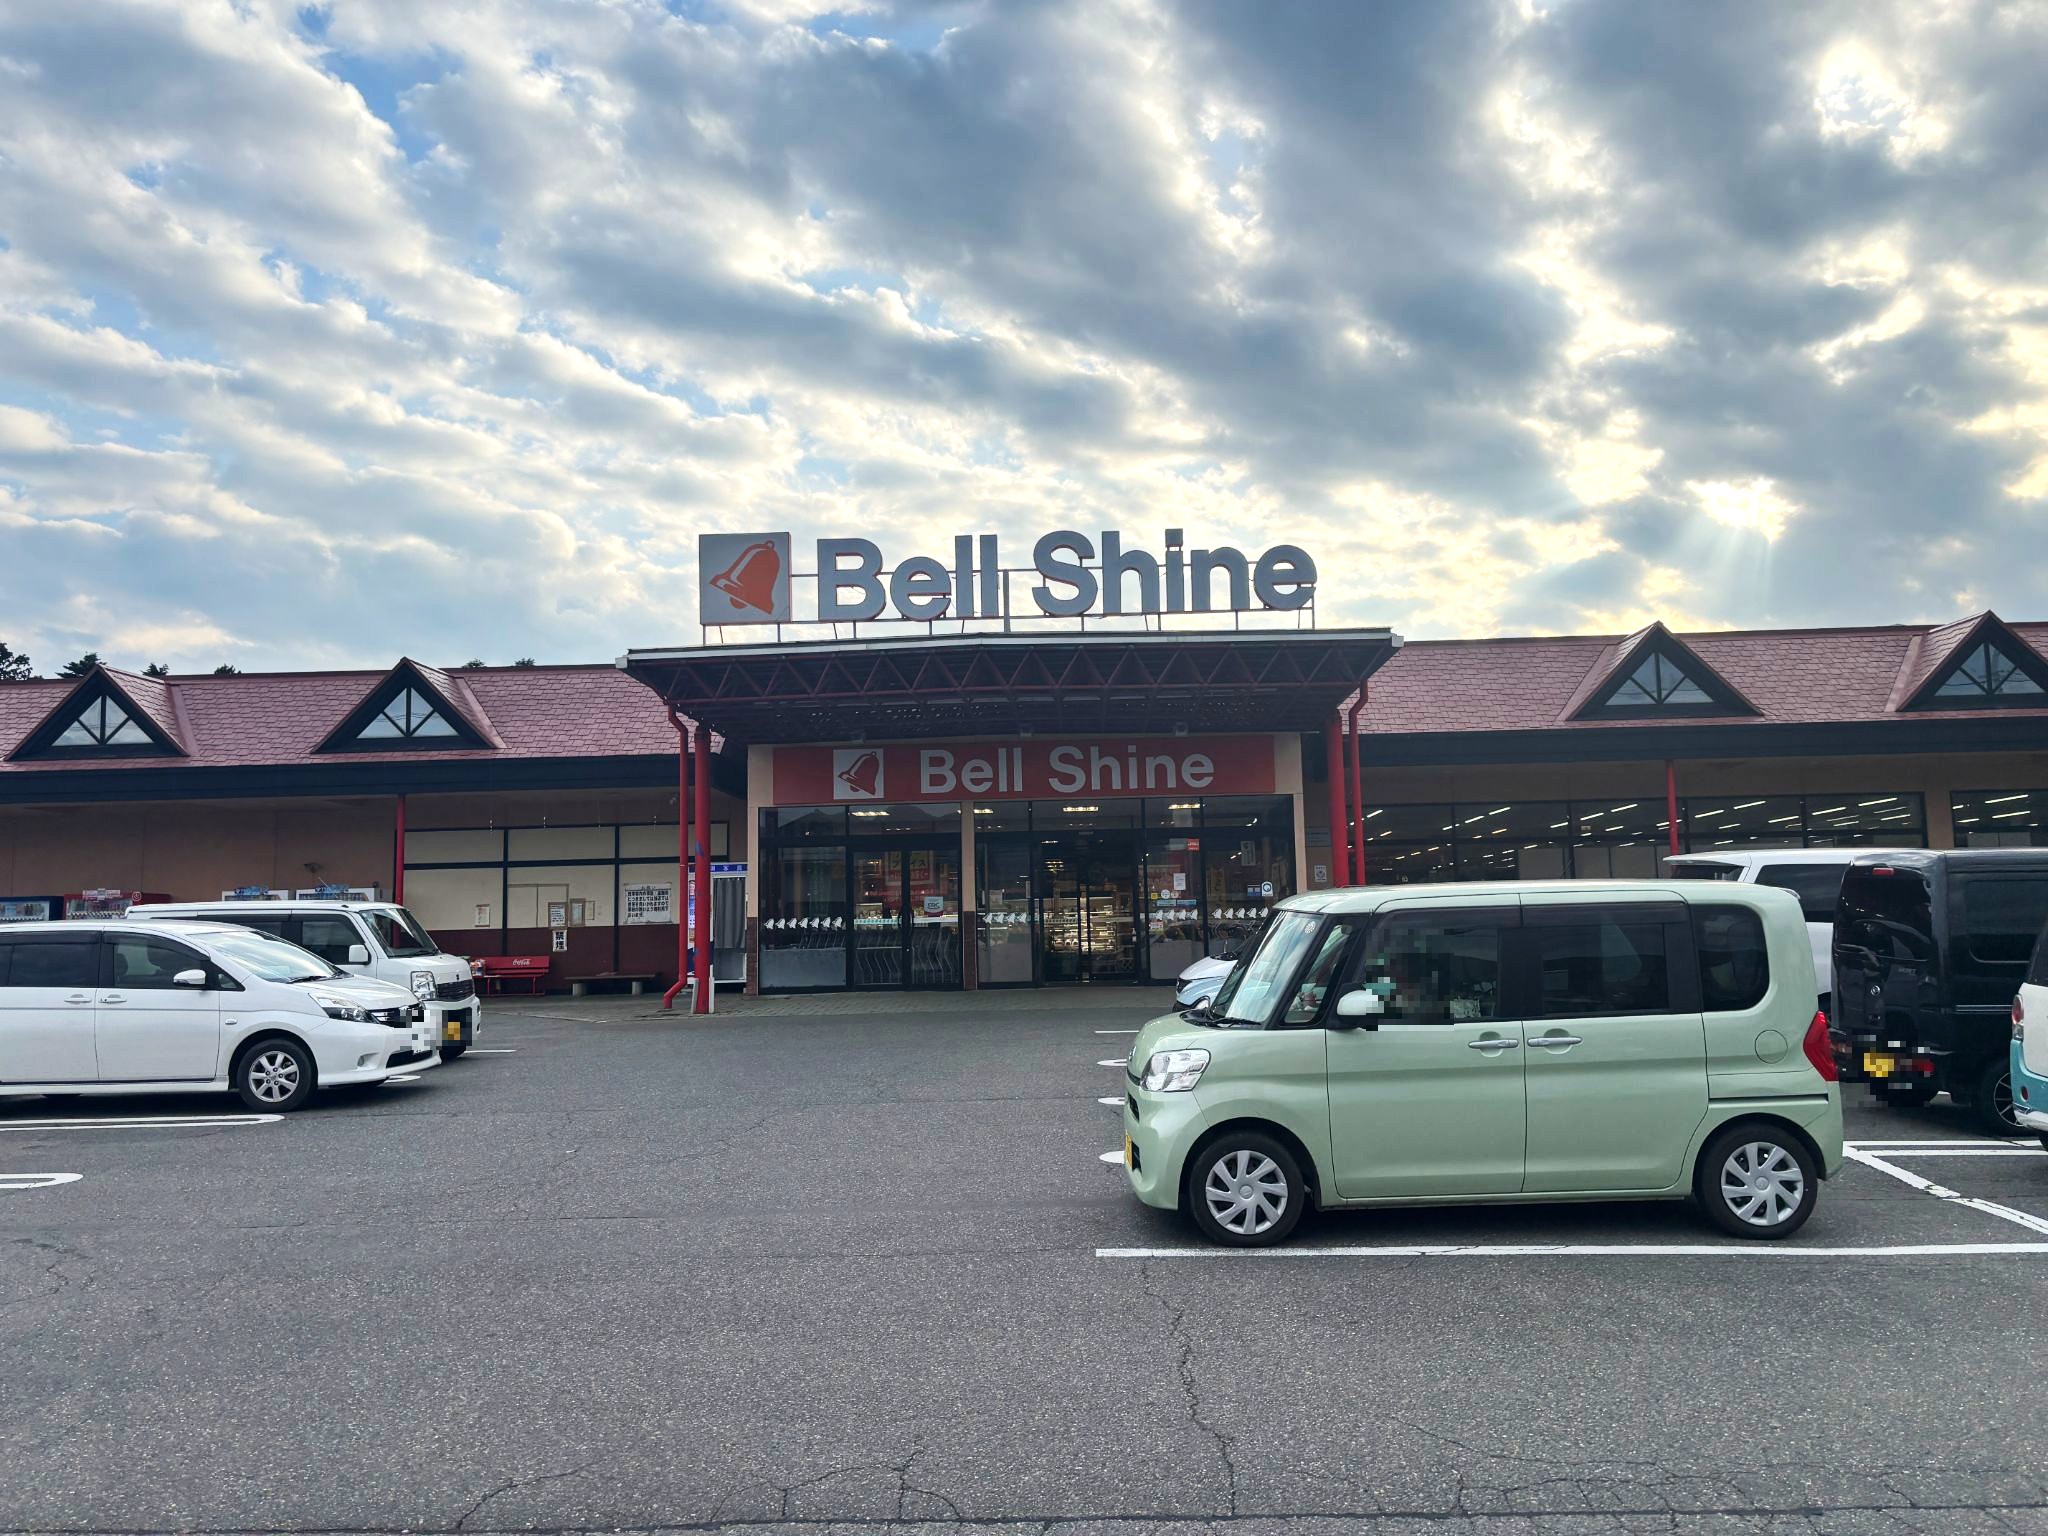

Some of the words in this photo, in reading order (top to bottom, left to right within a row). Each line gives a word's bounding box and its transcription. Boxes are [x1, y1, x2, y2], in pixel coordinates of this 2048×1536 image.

[818, 534, 1000, 622] Bell
[1032, 528, 1318, 618] Shine
[920, 747, 1023, 793] Bell
[1048, 744, 1215, 793] Shine
